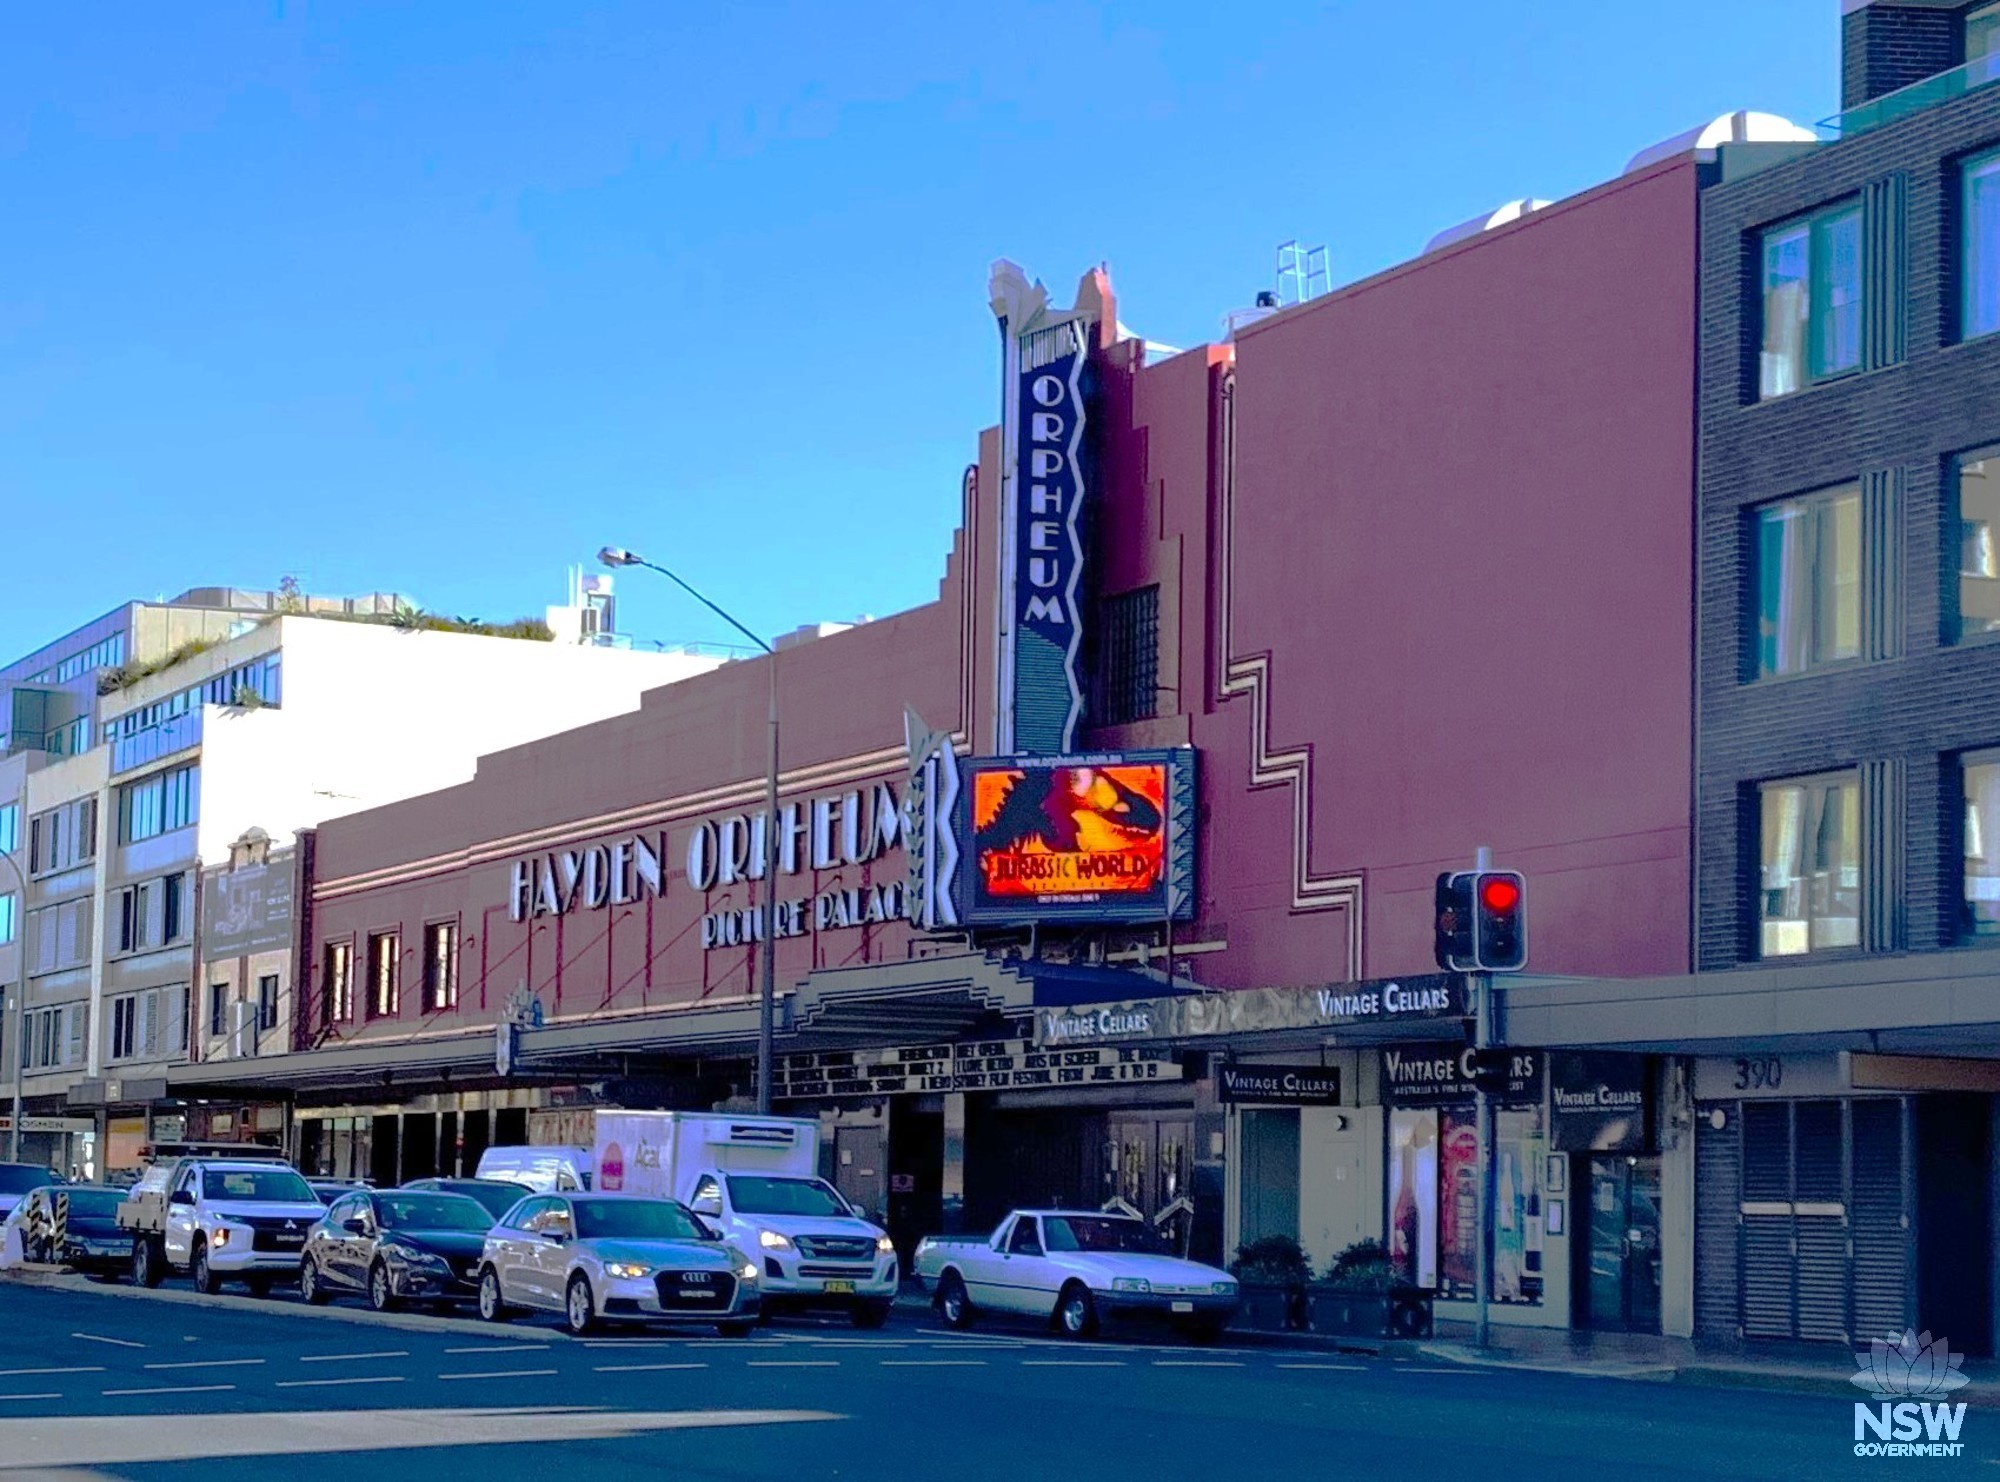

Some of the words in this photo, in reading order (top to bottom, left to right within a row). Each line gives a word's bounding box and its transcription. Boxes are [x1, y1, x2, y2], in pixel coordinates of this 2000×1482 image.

[1024, 375, 1065, 623] ORPHEUM
[509, 830, 666, 922] HAYDEN
[994, 855, 1071, 881] JURASSIC
[1076, 853, 1148, 880] WORLD
[701, 897, 806, 950] PICTURE
[1318, 989, 1379, 1016] VINTAGE
[1384, 984, 1450, 1012] CELLARS
[1047, 1014, 1096, 1037] VINTAGE
[1098, 1009, 1149, 1034] CELLARS
[1224, 1070, 1278, 1090] VINTAGE
[1283, 1073, 1335, 1092] CELLARS
[1385, 1050, 1456, 1084] VINTAGE
[1735, 1057, 1783, 1090] 390
[1554, 1086, 1595, 1105] VINTAGE
[1598, 1084, 1642, 1104] CELLARS
